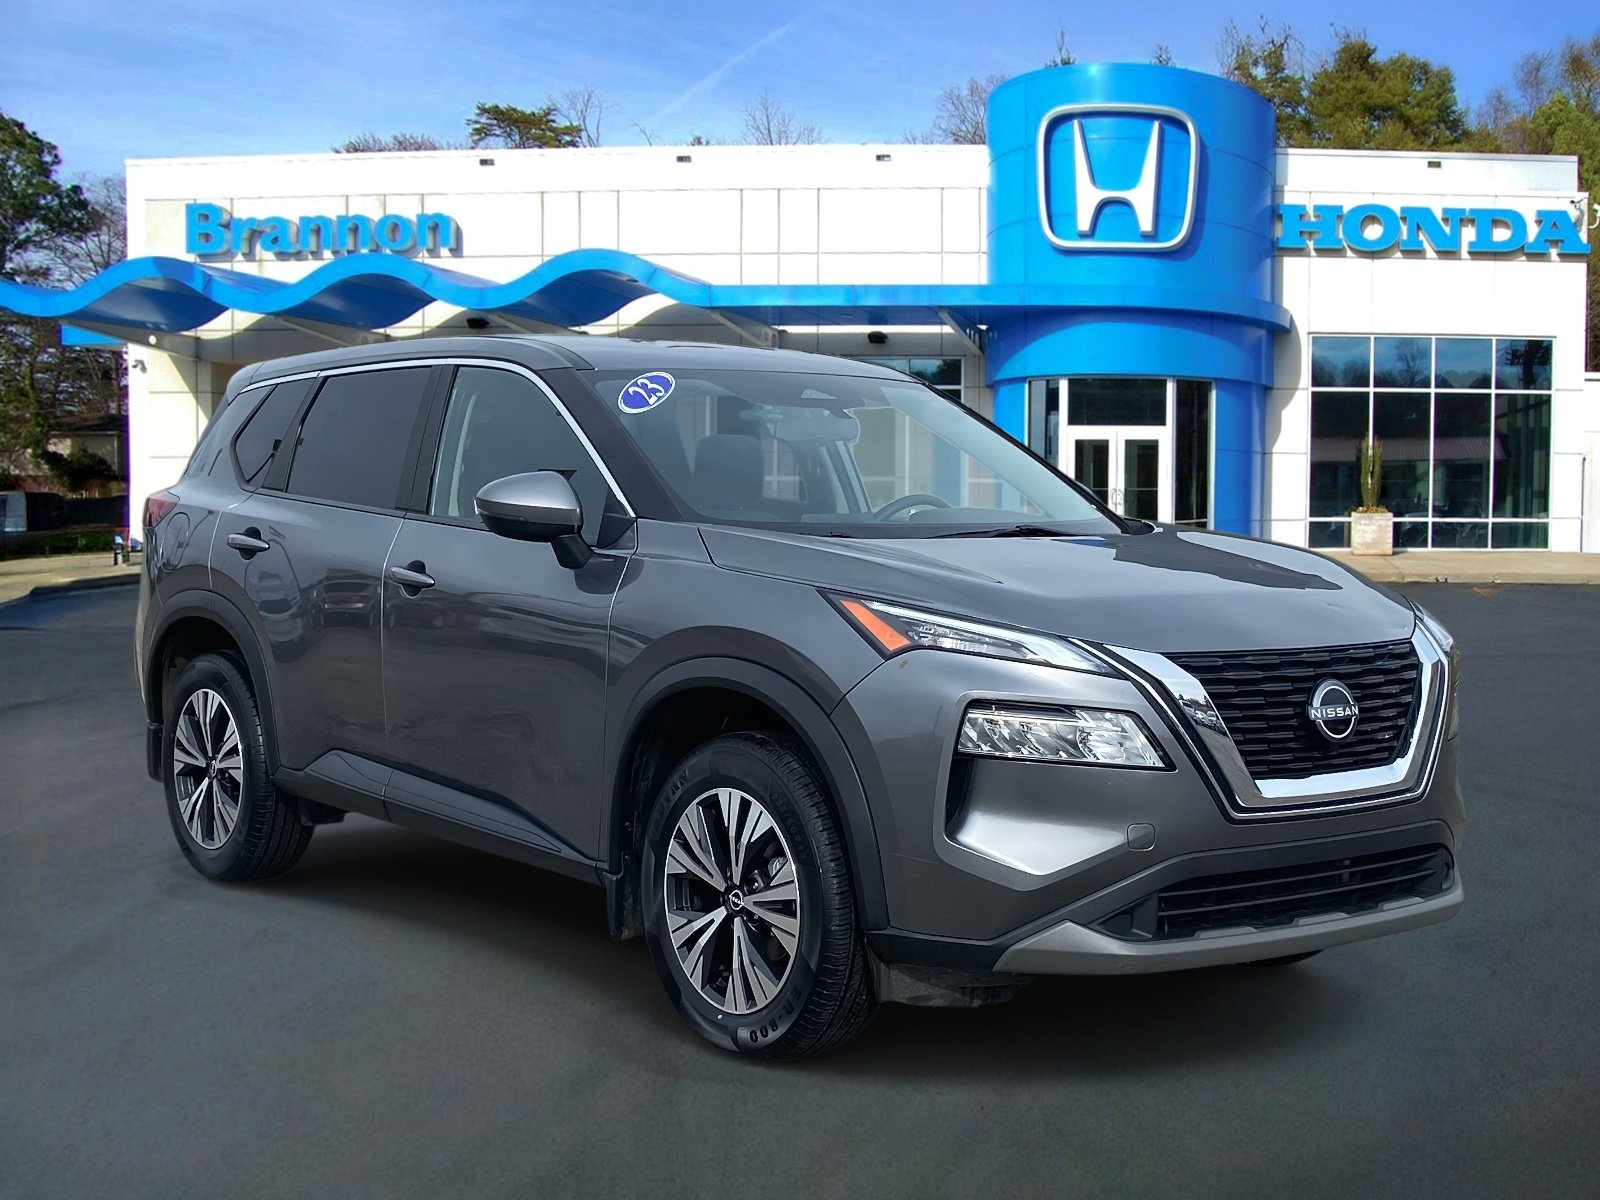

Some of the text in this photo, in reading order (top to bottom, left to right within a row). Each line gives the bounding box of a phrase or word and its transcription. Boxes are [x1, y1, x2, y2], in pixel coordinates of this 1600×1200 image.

[185, 202, 457, 254] Brannon
[1276, 203, 1591, 254] HONDA
[628, 378, 665, 405] 23
[1310, 705, 1359, 719] NISSAN
